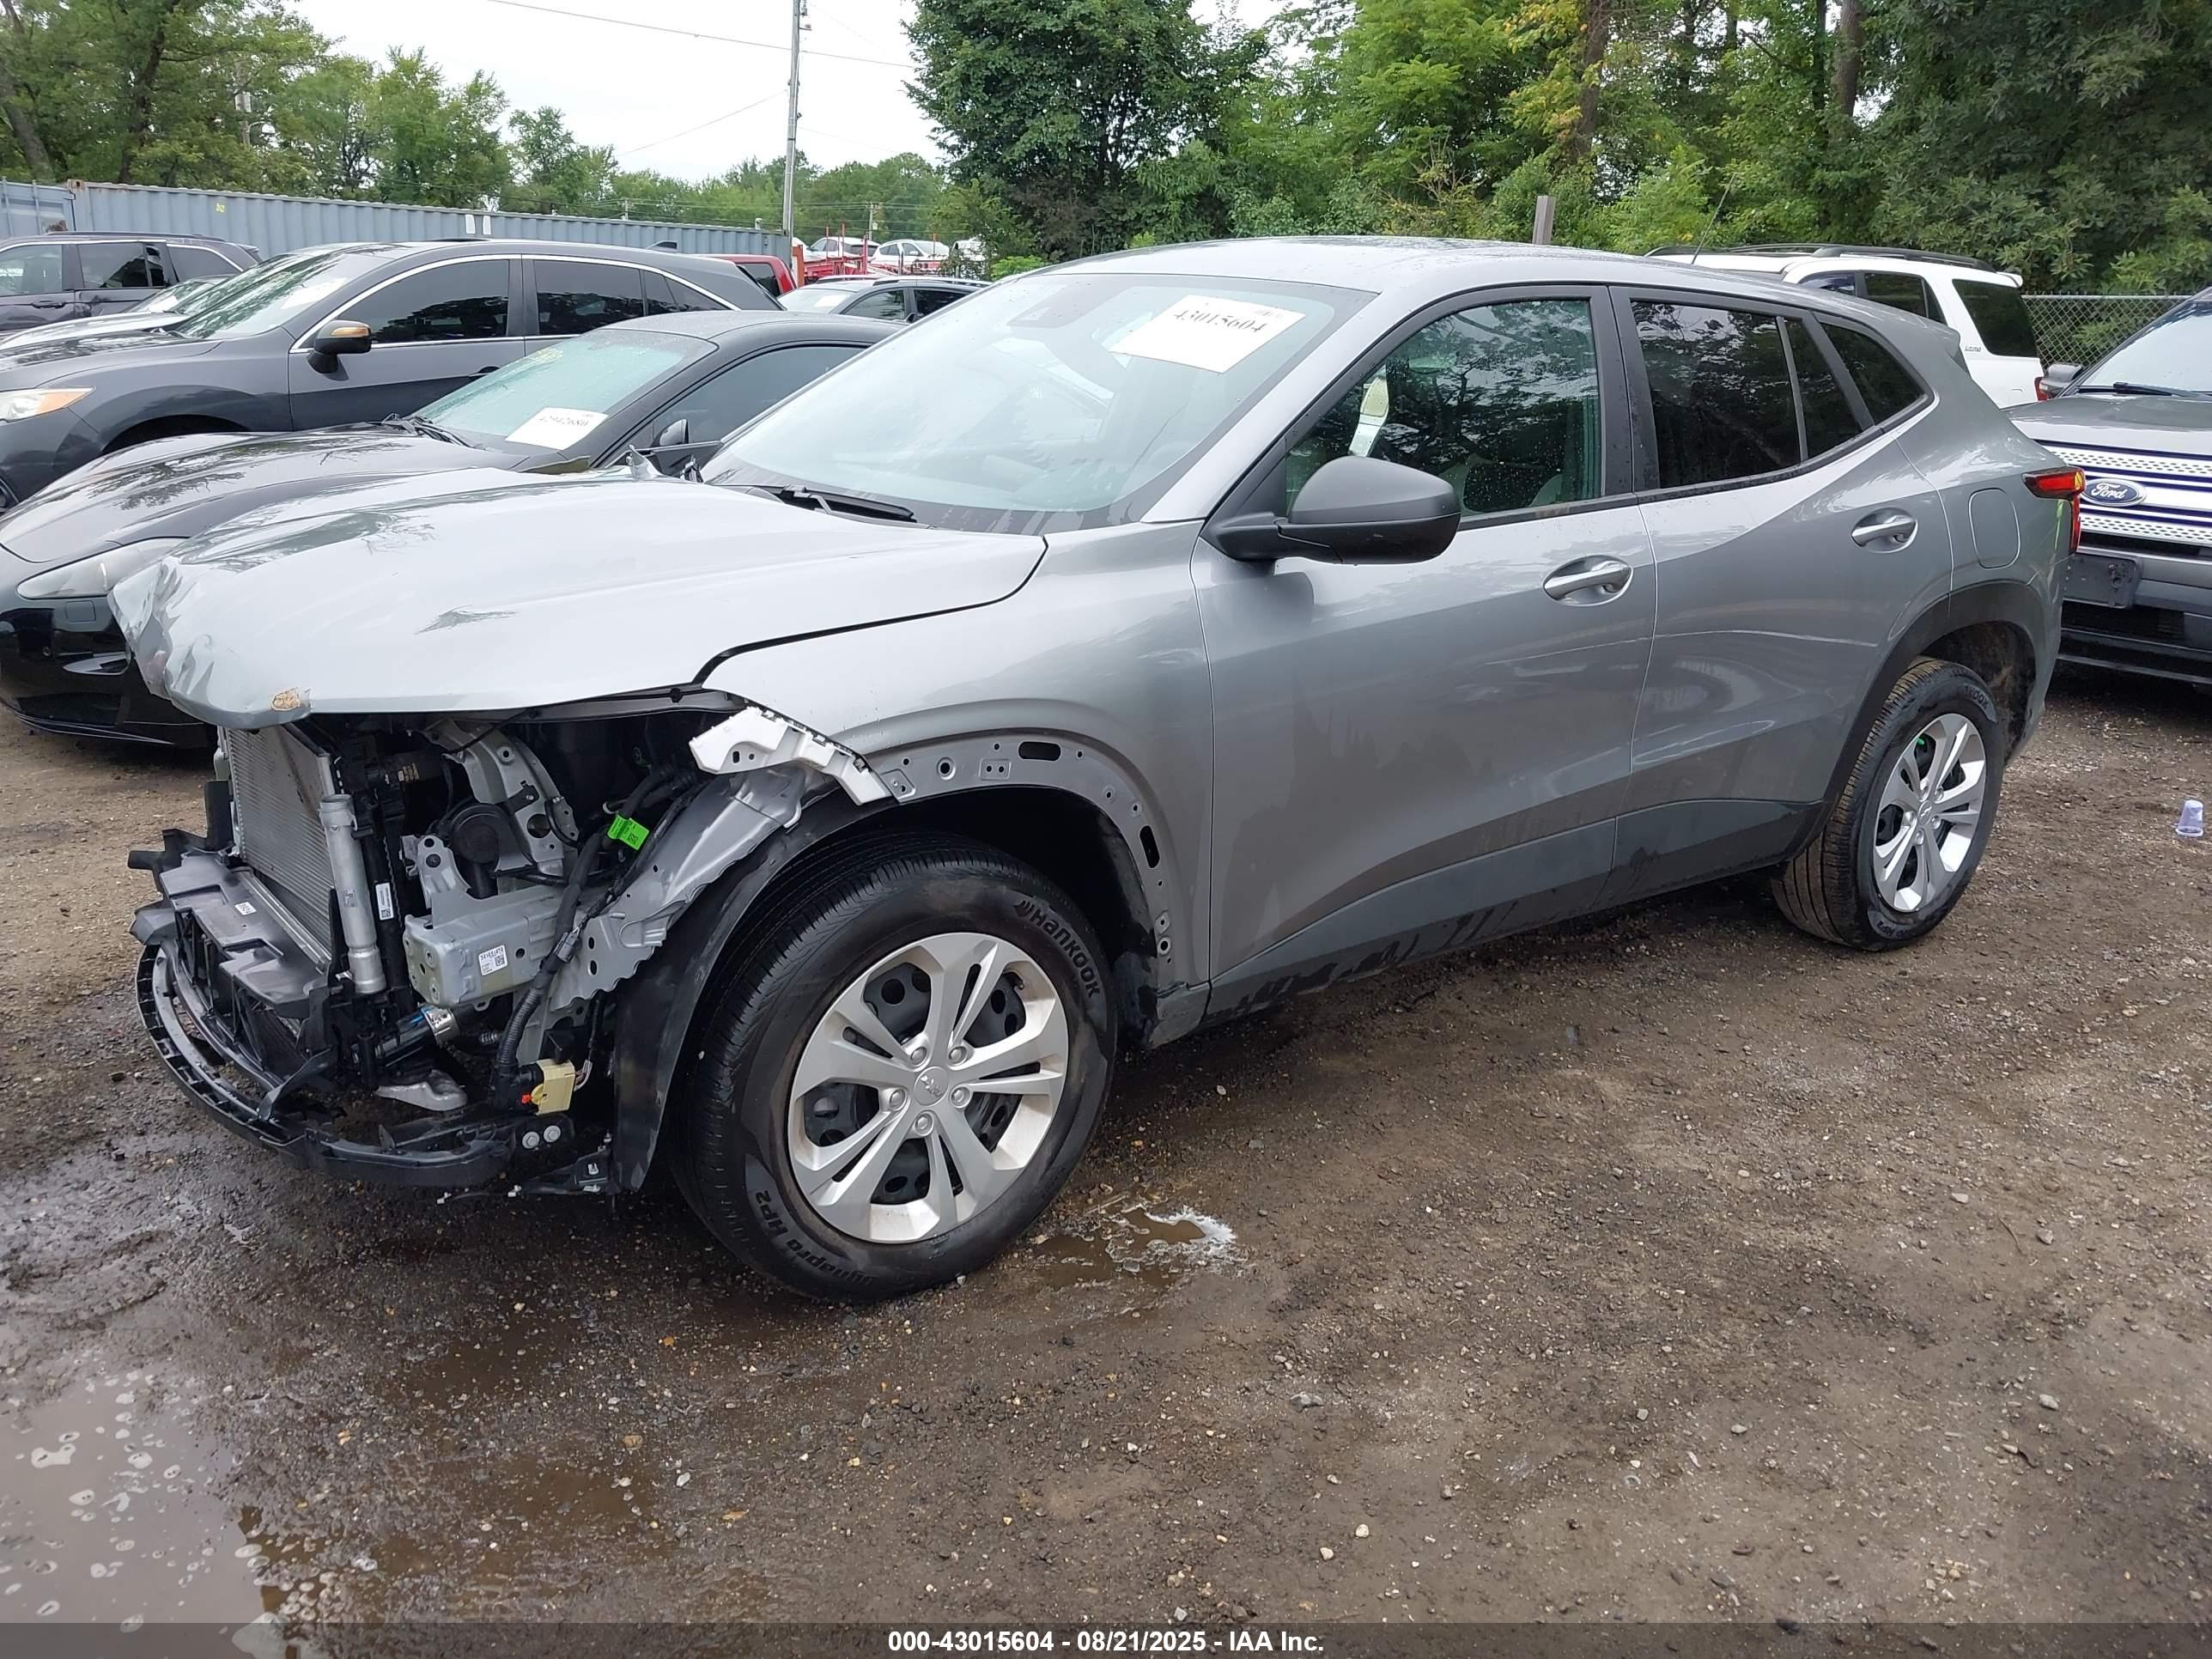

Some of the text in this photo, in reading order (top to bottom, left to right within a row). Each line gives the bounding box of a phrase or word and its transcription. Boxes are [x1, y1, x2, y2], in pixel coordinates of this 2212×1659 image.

[1174, 309, 1268, 333] 43015604
[2091, 482, 2129, 499] Ford
[1030, 908, 1100, 999] Hankook
[755, 1189, 789, 1237] HP2
